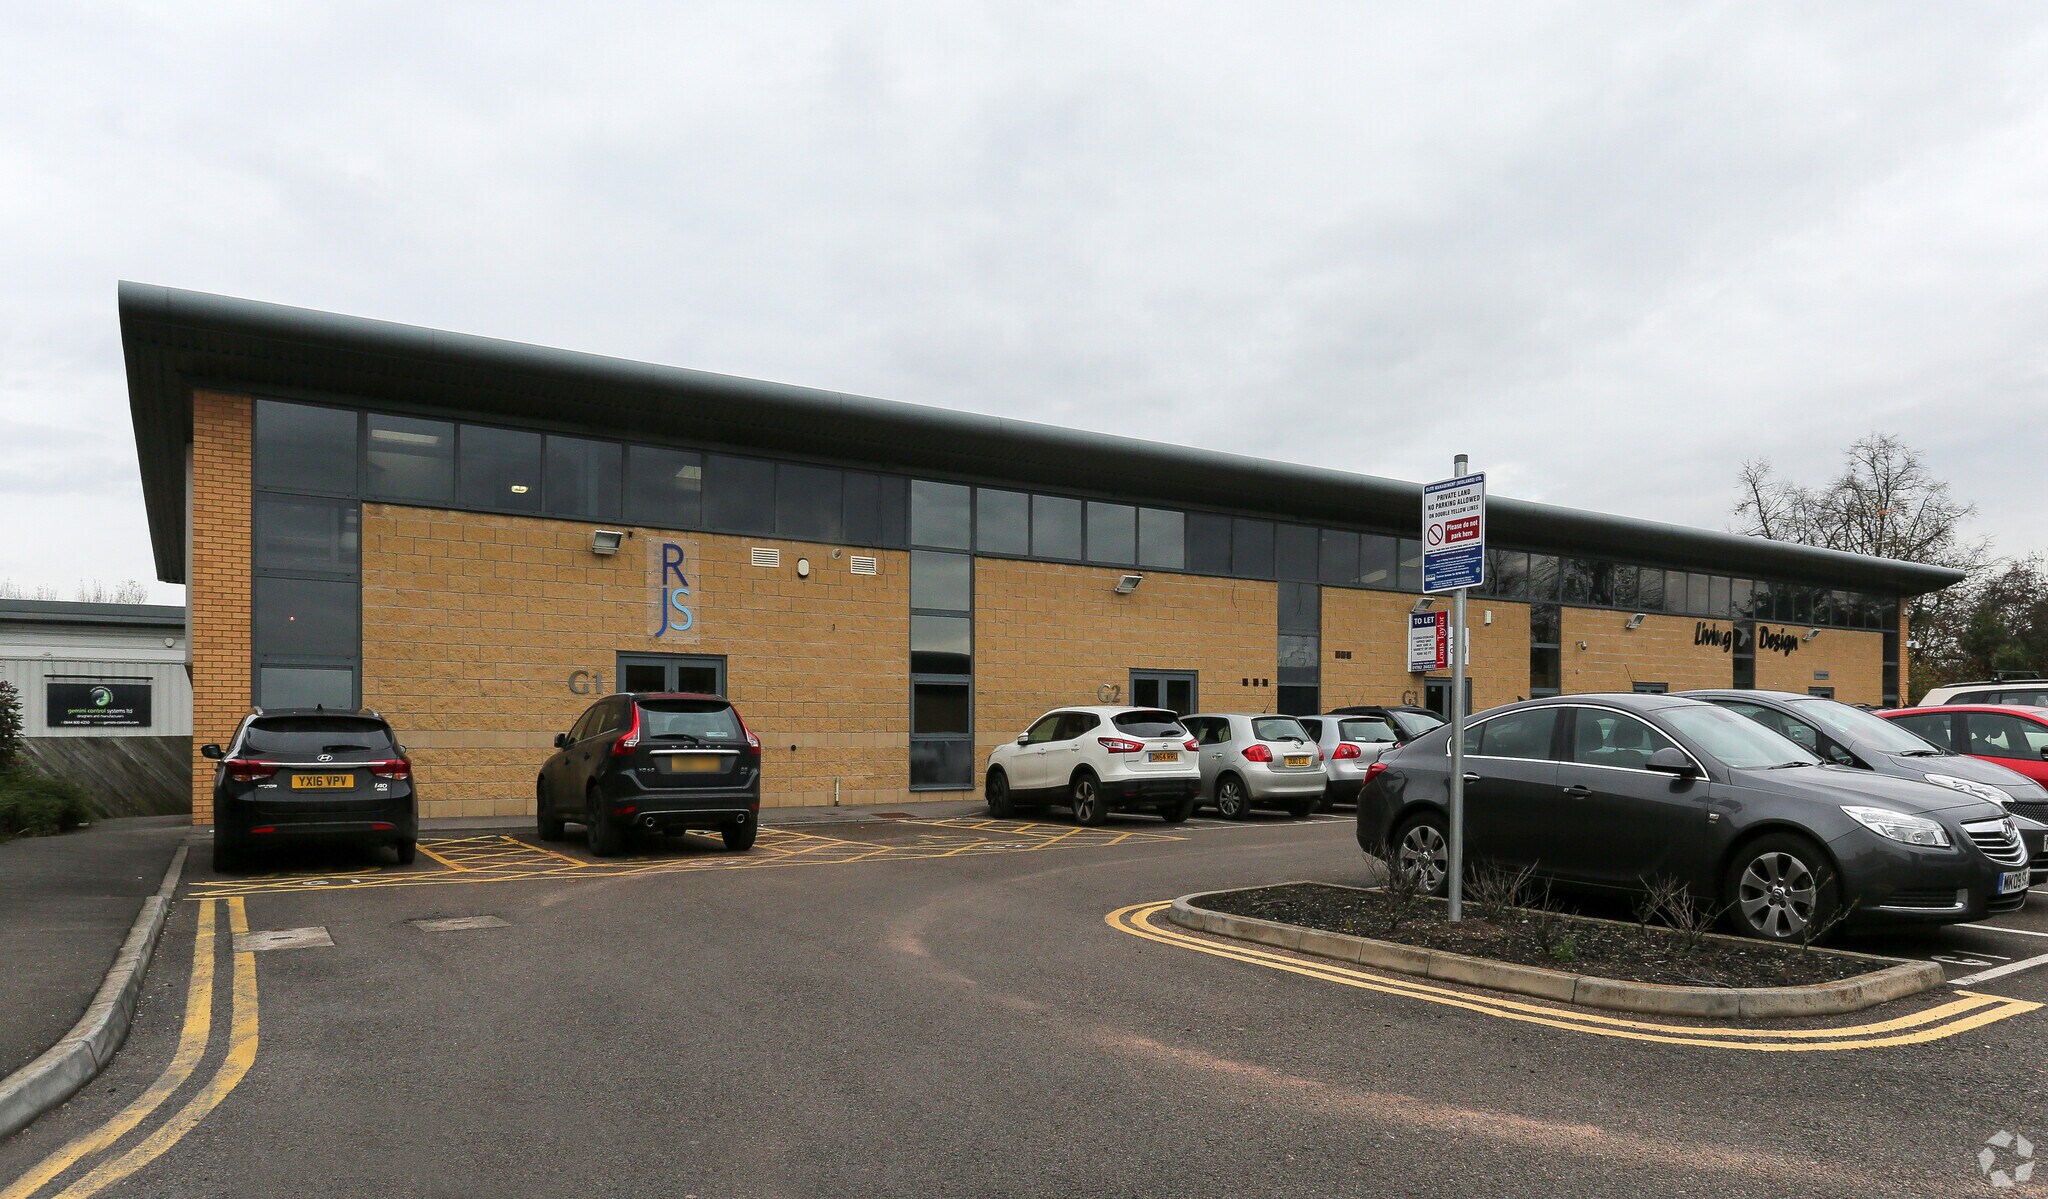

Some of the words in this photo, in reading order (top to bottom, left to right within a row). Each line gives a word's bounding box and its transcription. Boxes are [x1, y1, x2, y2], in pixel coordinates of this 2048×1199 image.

[1435, 481, 1456, 491] MANAGEMENT
[1437, 491, 1456, 501] PRIVATE
[1458, 488, 1470, 497] LAND
[1428, 503, 1434, 511] NO
[1435, 499, 1456, 510] PARKING
[1457, 494, 1480, 505] ALLOWED
[1435, 510, 1450, 518] DOUBLE
[1451, 506, 1466, 515] YELLOW
[1467, 504, 1479, 512] LINES
[1446, 523, 1462, 531] Please
[1450, 532, 1462, 541] park
[662, 543, 689, 587] R
[655, 587, 693, 637] JS
[1413, 617, 1422, 625] TO
[1423, 616, 1434, 624] LET
[1437, 616, 1446, 641] Taylor
[1694, 621, 1732, 653] Living
[1759, 626, 1798, 657] Design
[1437, 642, 1445, 664] Louis
[568, 669, 603, 694] G1
[1097, 683, 1121, 703] G2
[298, 776, 323, 786] YX16
[326, 776, 347, 786] VPV
